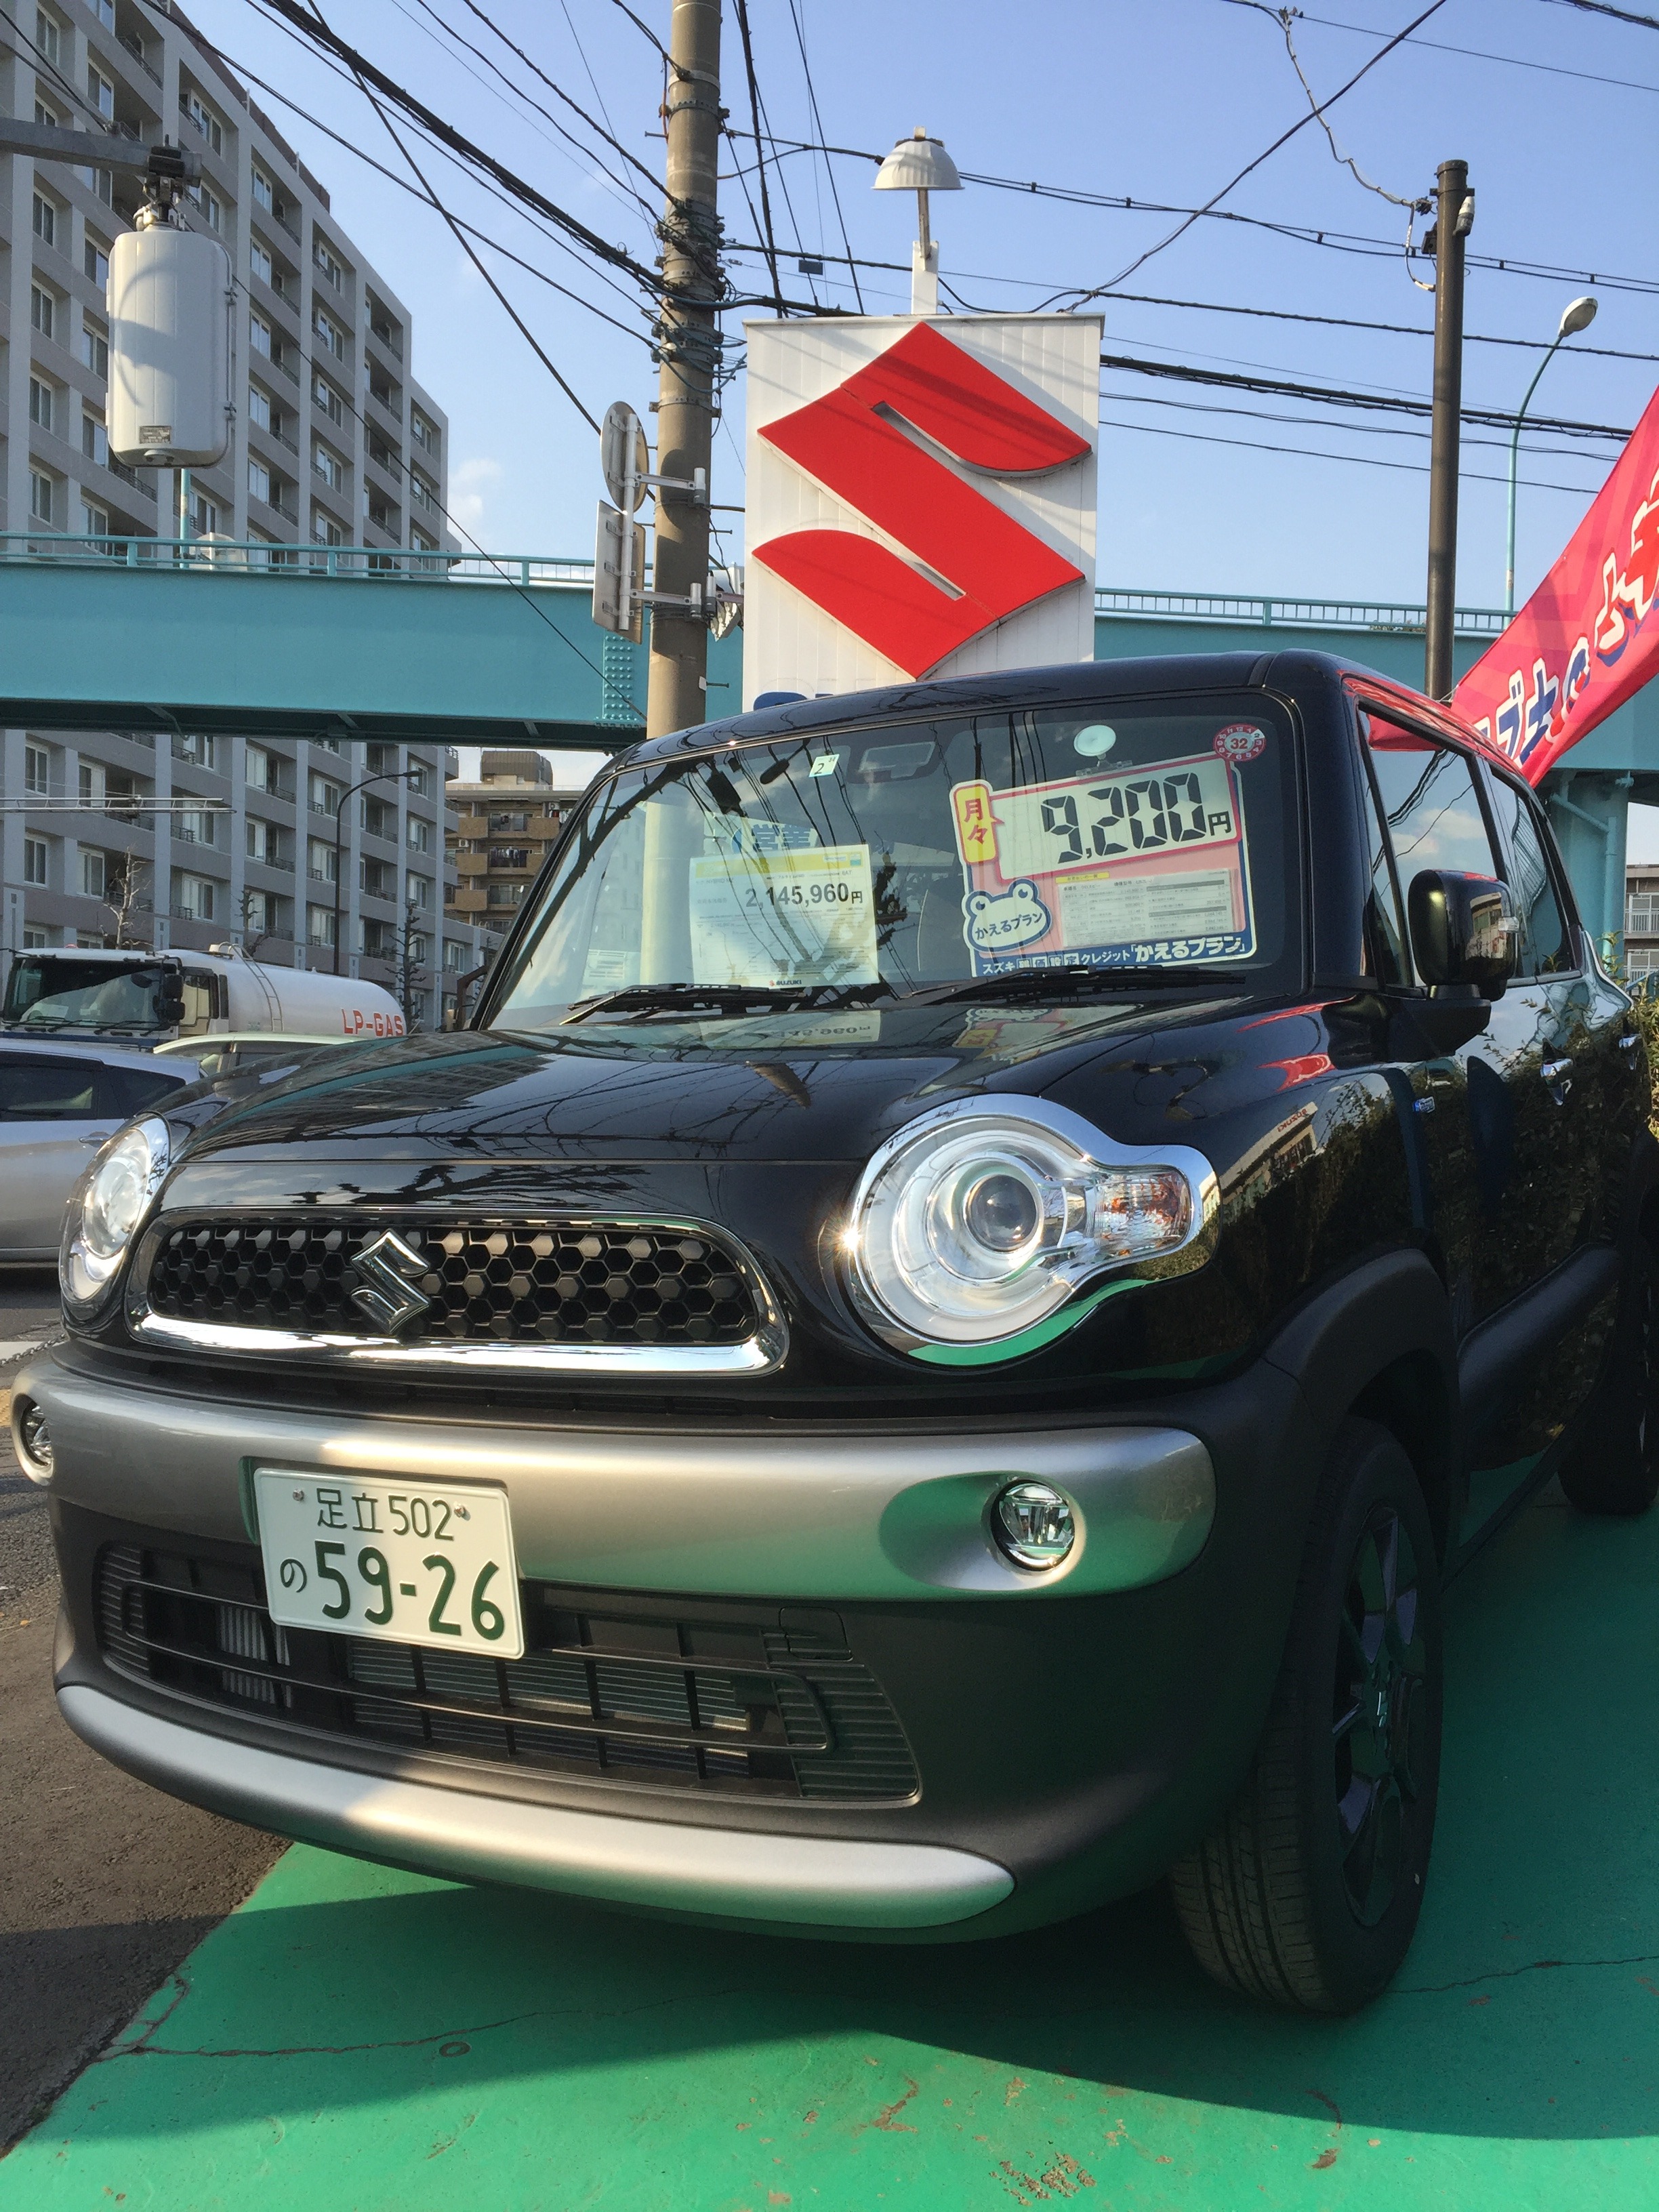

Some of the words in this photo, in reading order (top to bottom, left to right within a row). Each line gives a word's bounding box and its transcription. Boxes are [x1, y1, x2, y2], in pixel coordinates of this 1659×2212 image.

[1230, 738, 1248, 750] 32
[814, 762, 825, 775] 2
[964, 798, 987, 844] 月々
[975, 912, 1043, 941] かえるプラン
[341, 1008, 404, 1037] LP-GAS
[280, 1558, 307, 1593] の
[314, 1540, 505, 1640] 59-26
